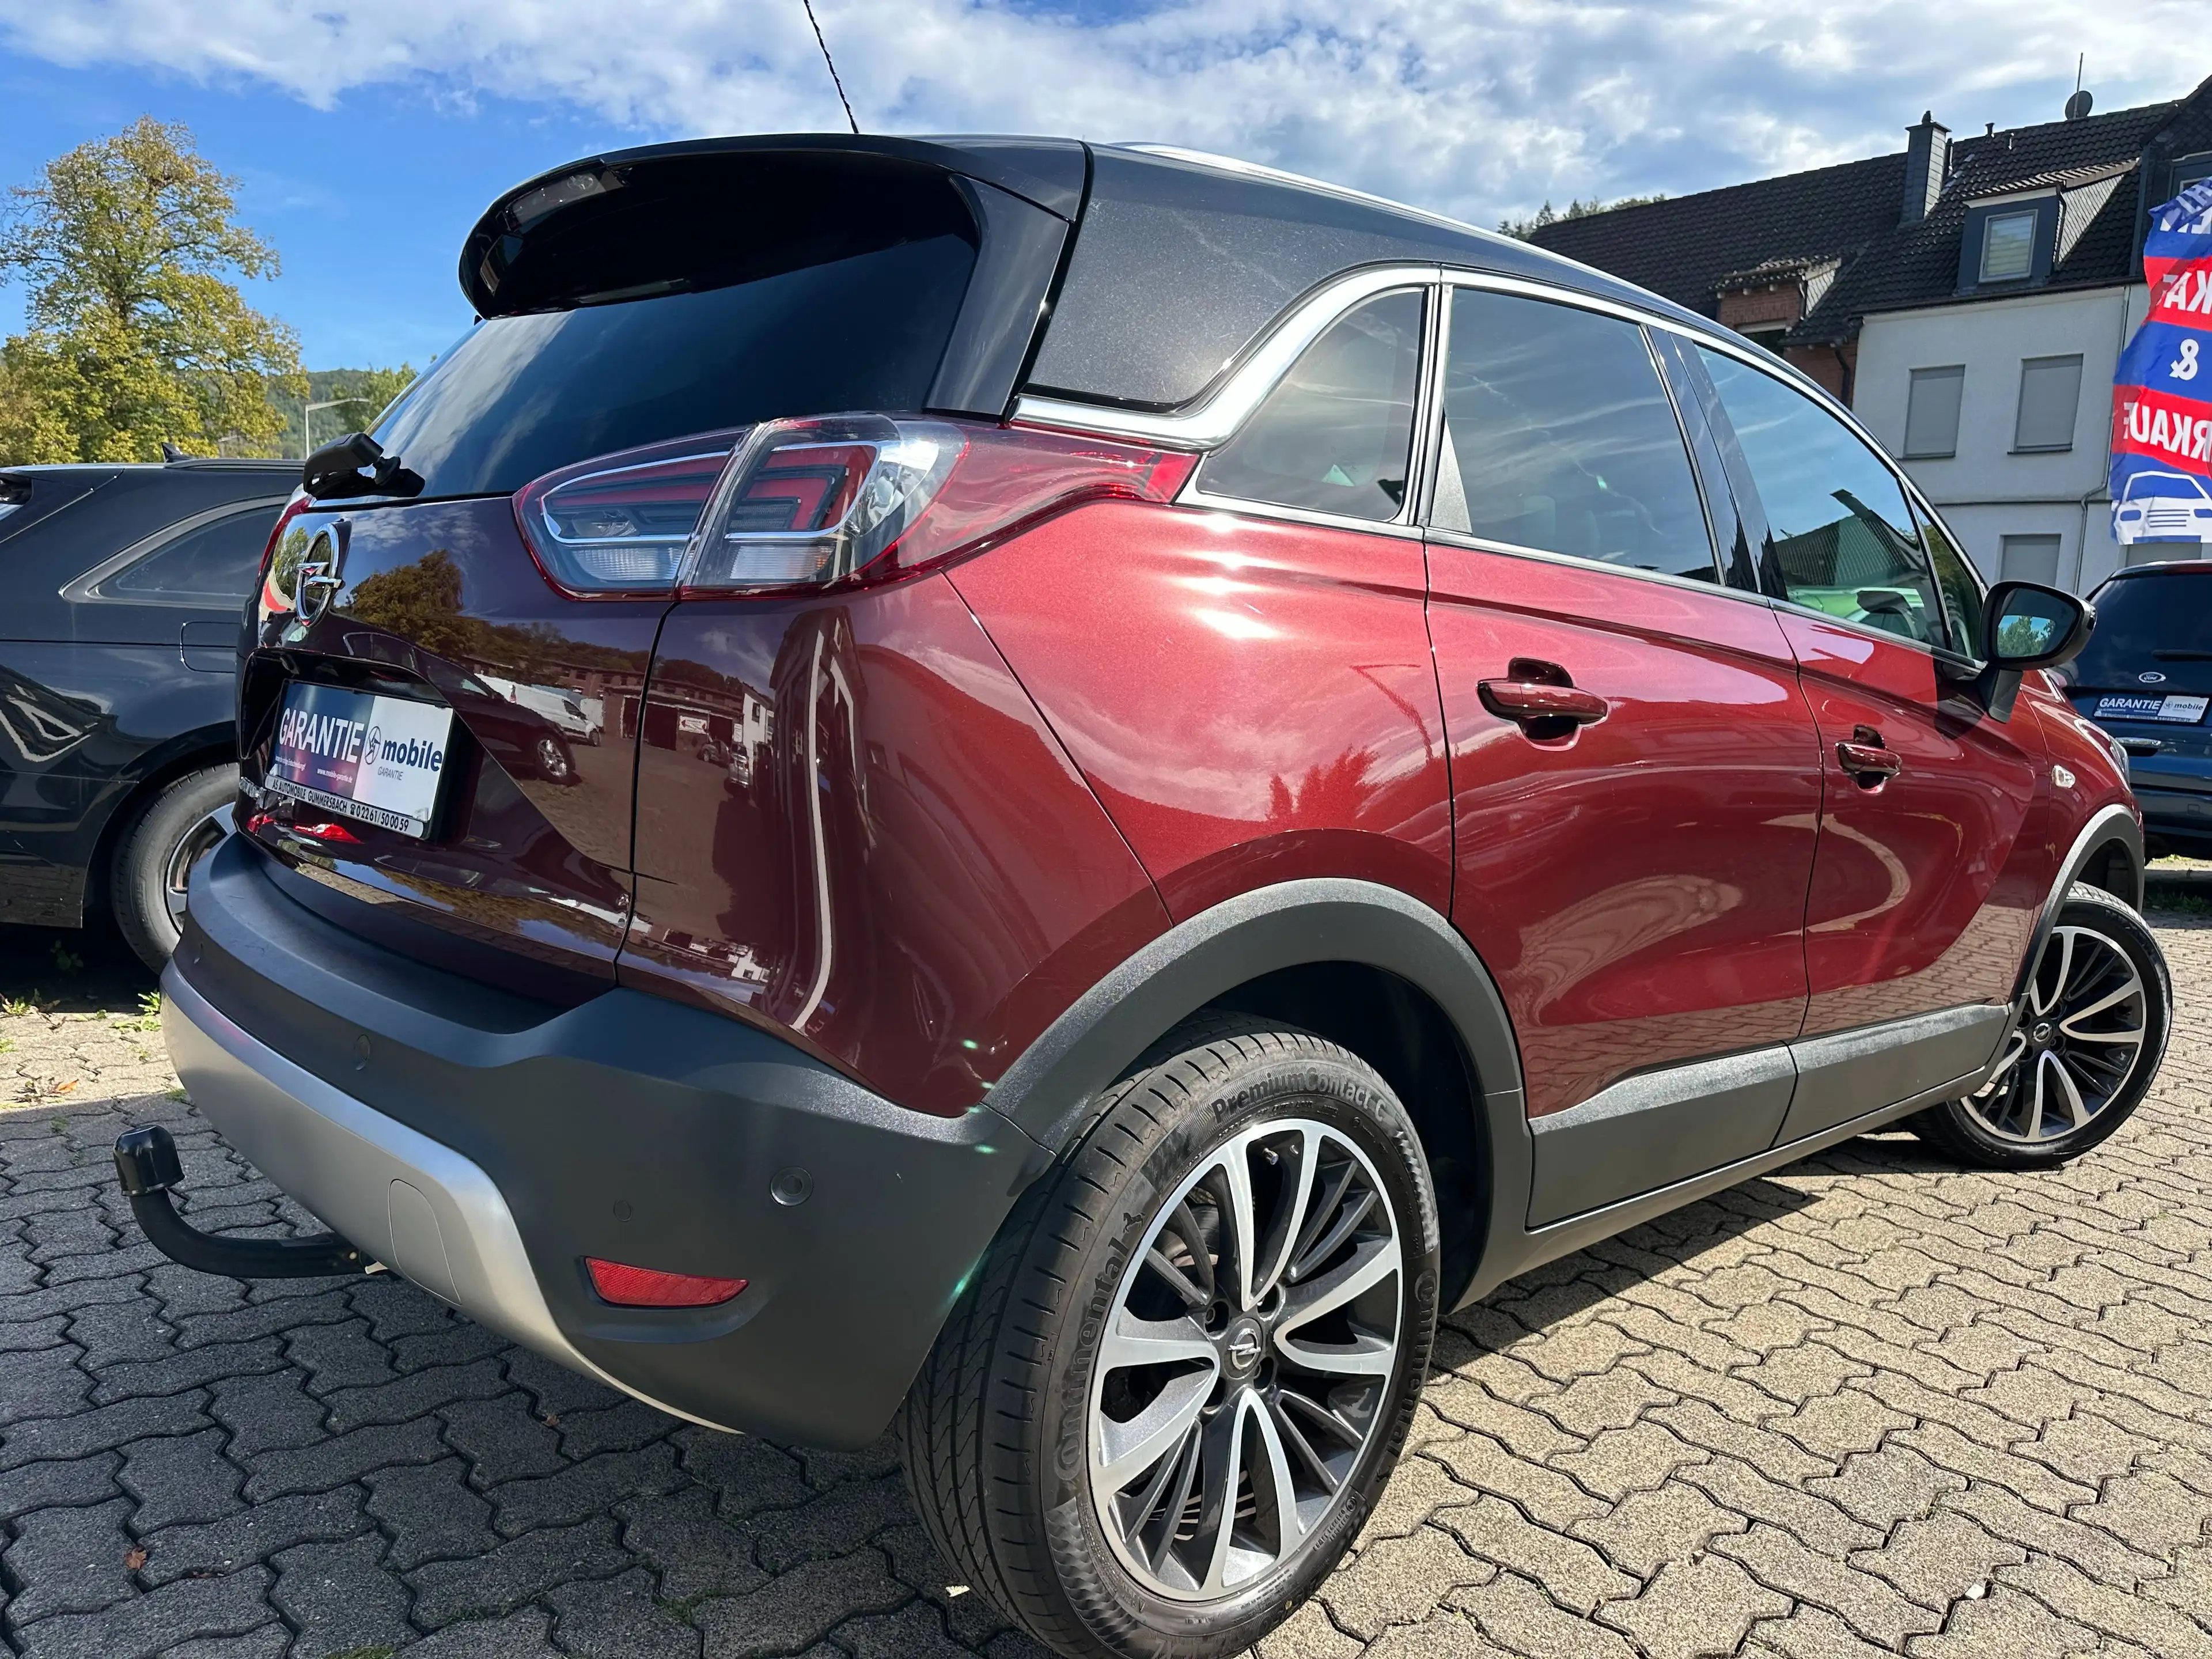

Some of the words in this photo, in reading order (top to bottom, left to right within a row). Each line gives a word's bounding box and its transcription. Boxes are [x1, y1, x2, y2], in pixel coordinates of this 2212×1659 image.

[2100, 698, 2162, 710] GARANTIE
[2174, 703, 2204, 711] mobile
[279, 707, 365, 764] GARANTIE
[381, 737, 443, 772] mobile
[377, 766, 404, 781] GARANTIE
[272, 779, 279, 790] AS
[278, 781, 306, 800] AUTOMOBILE
[308, 790, 347, 813] GUMMERSBACH
